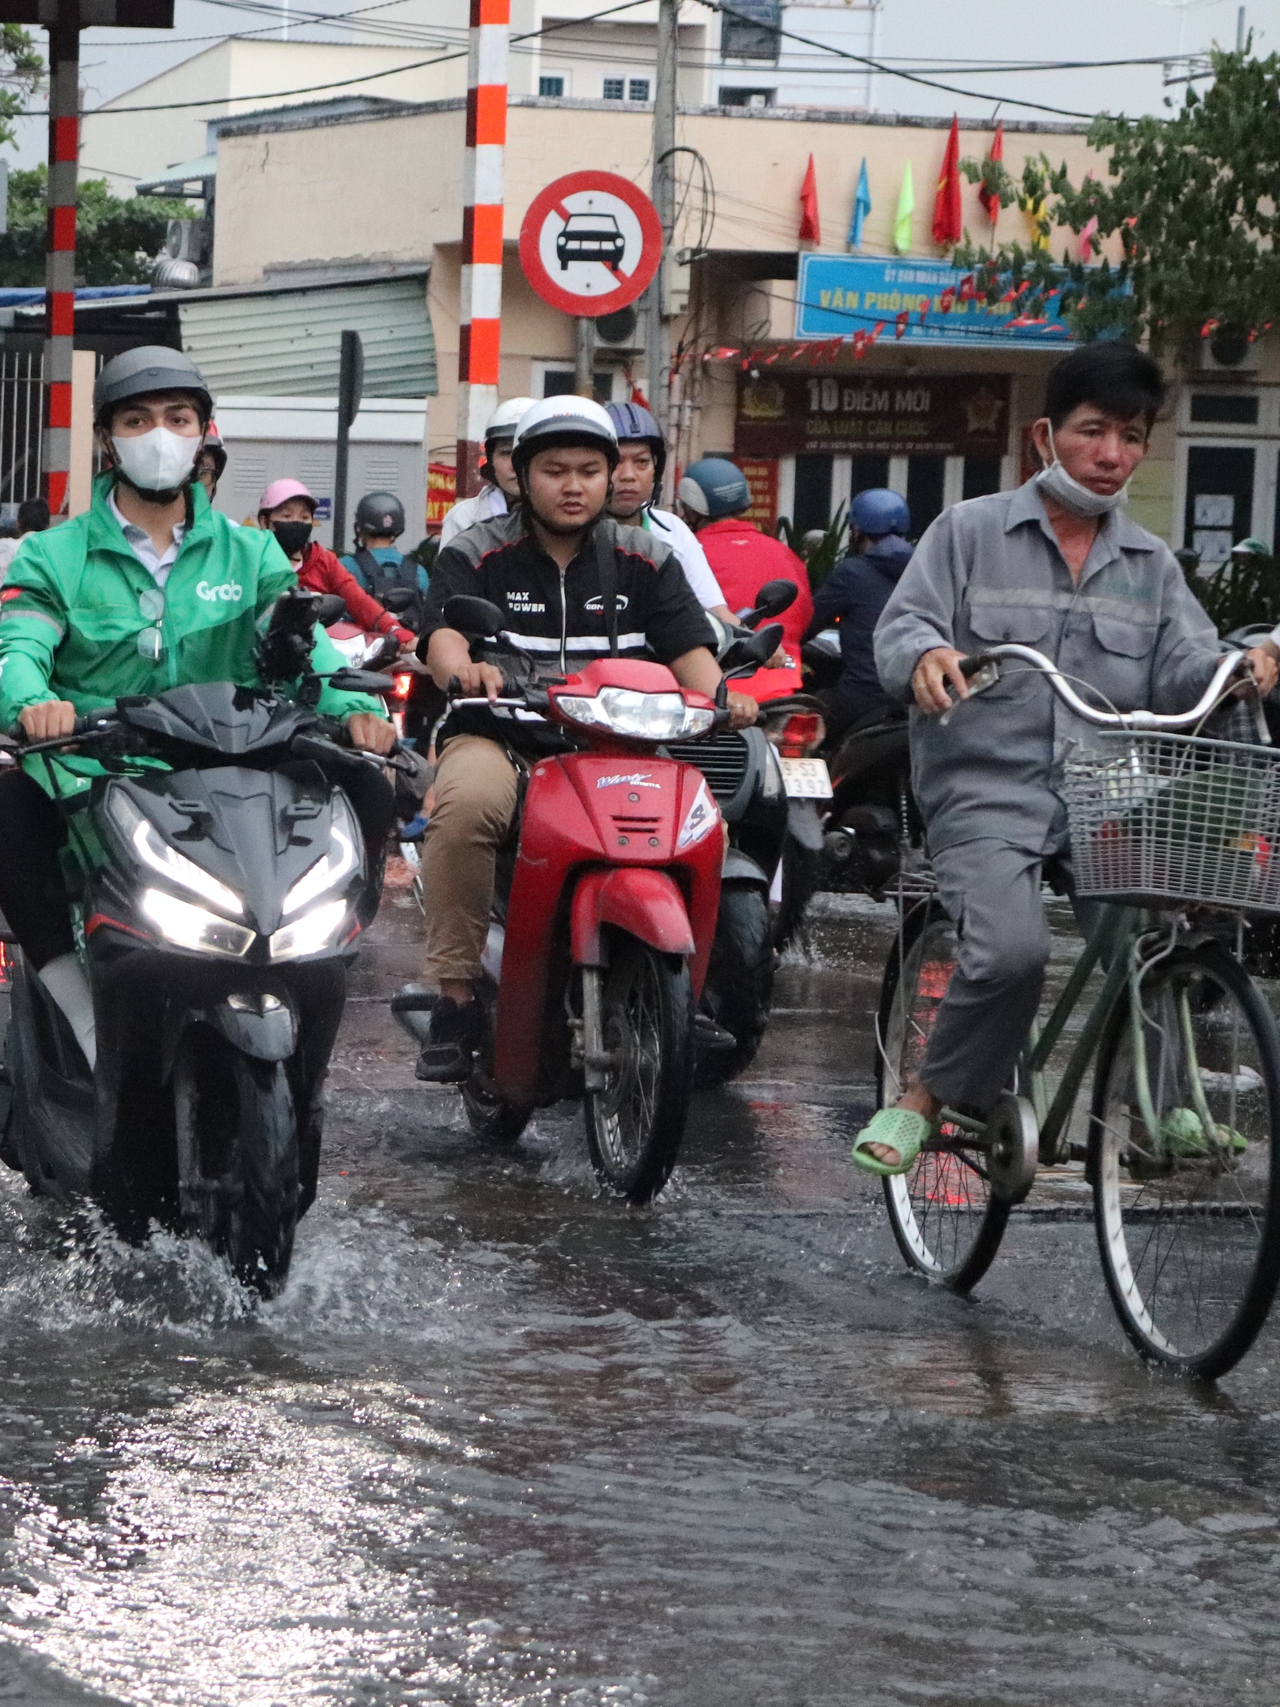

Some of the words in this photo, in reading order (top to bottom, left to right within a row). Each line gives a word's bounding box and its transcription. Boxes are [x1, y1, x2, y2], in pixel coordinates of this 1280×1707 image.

[820, 288, 859, 308] VĂN
[806, 377, 839, 411] 10
[842, 380, 889, 412] ĐIỂM
[195, 579, 243, 601] Grab
[506, 591, 530, 601] MAX
[508, 602, 546, 613] POWER
